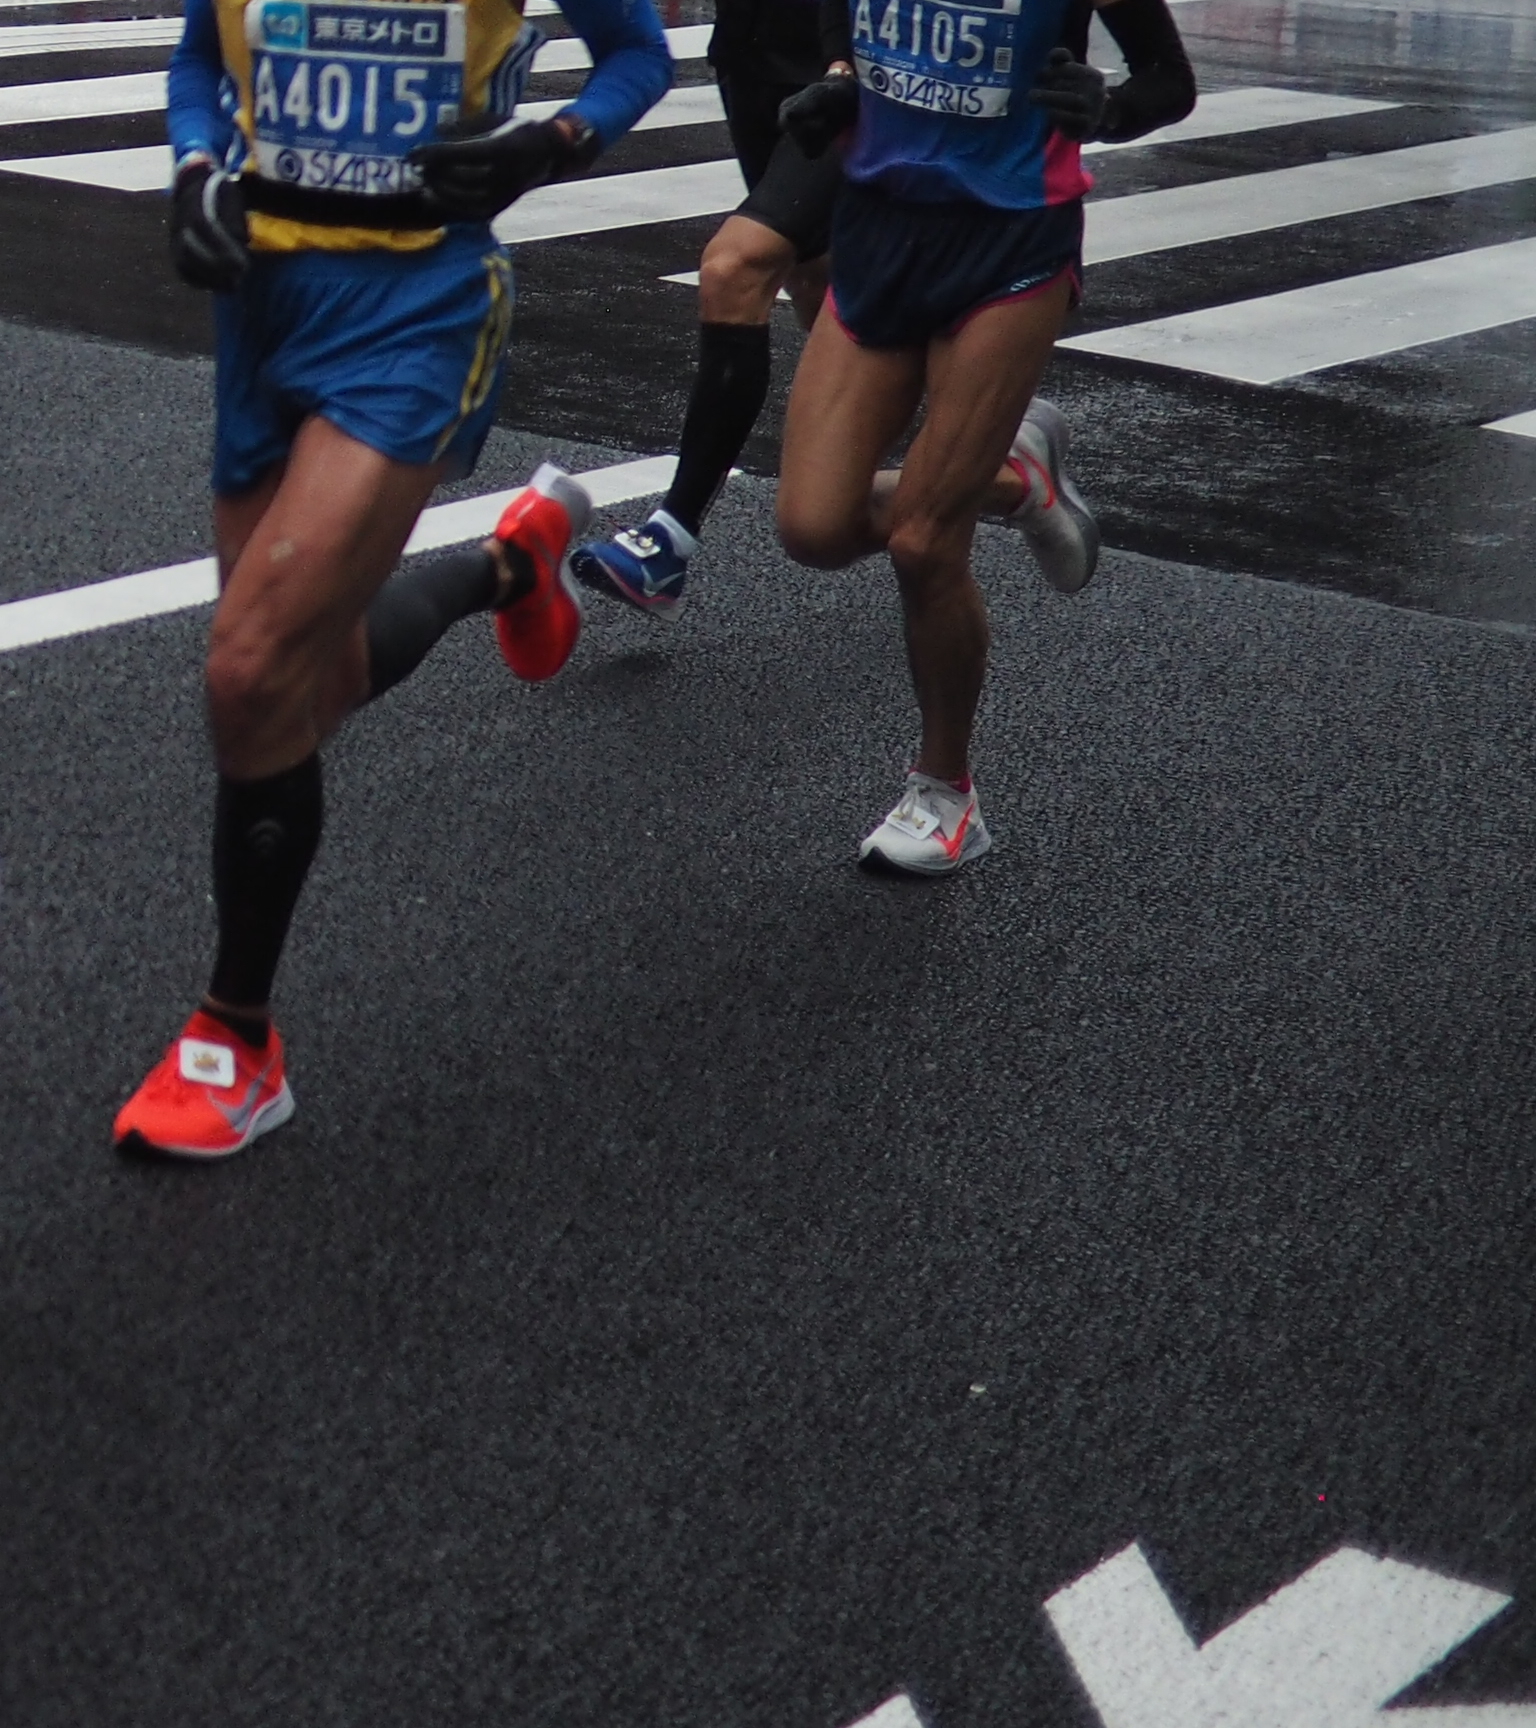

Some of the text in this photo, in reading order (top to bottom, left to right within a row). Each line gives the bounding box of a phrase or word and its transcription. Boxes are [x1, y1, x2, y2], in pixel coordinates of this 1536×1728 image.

[313, 15, 440, 46] 東京メトロ
[255, 55, 429, 137] A4015
